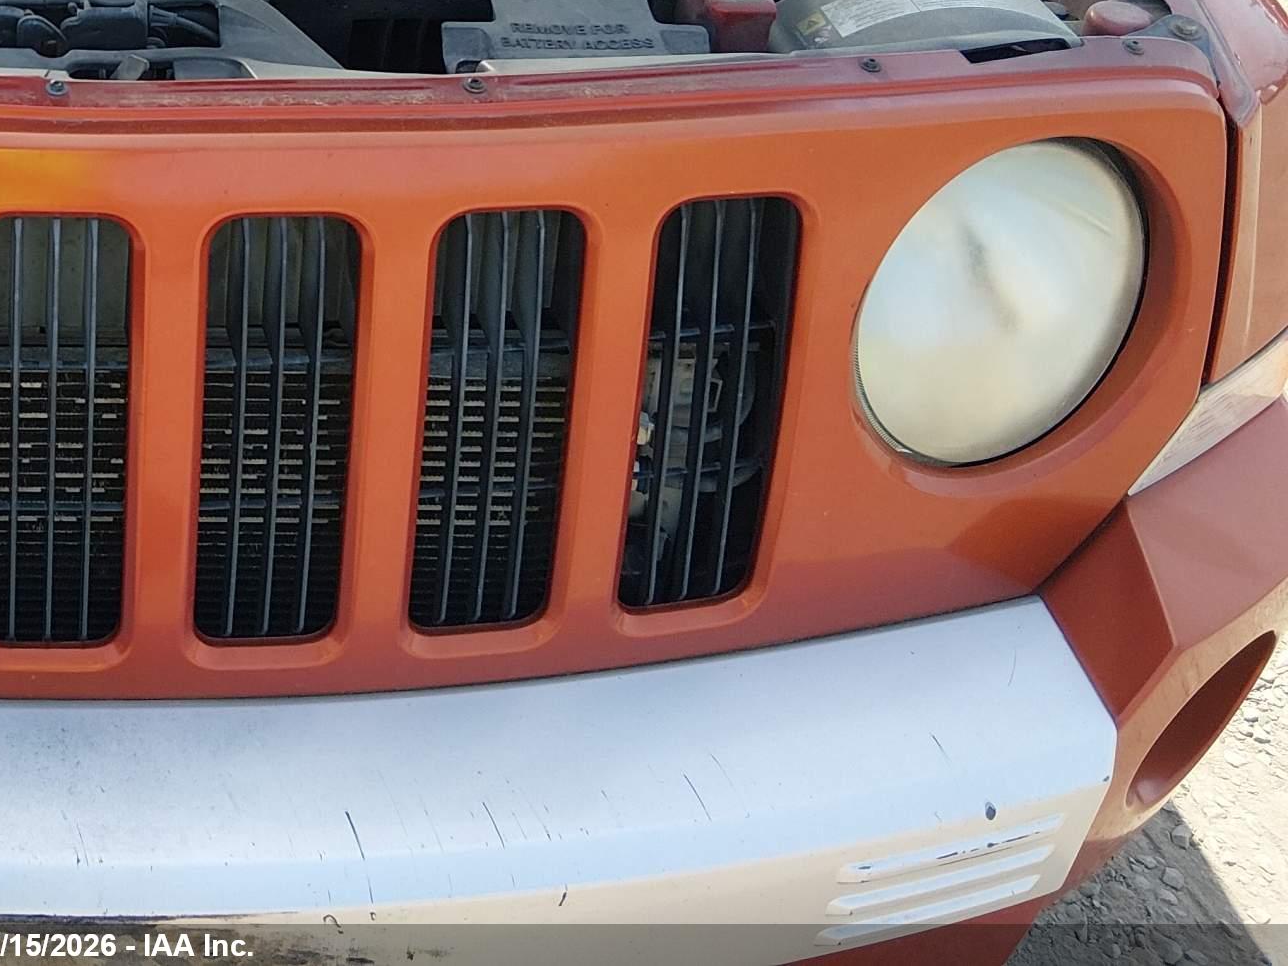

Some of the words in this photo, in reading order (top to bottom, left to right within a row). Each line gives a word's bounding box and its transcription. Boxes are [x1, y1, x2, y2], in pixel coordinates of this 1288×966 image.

[510, 22, 586, 35] REMOVE
[591, 24, 630, 35] FOR
[500, 37, 577, 50] BATTERY
[585, 38, 655, 50] ACCESS
